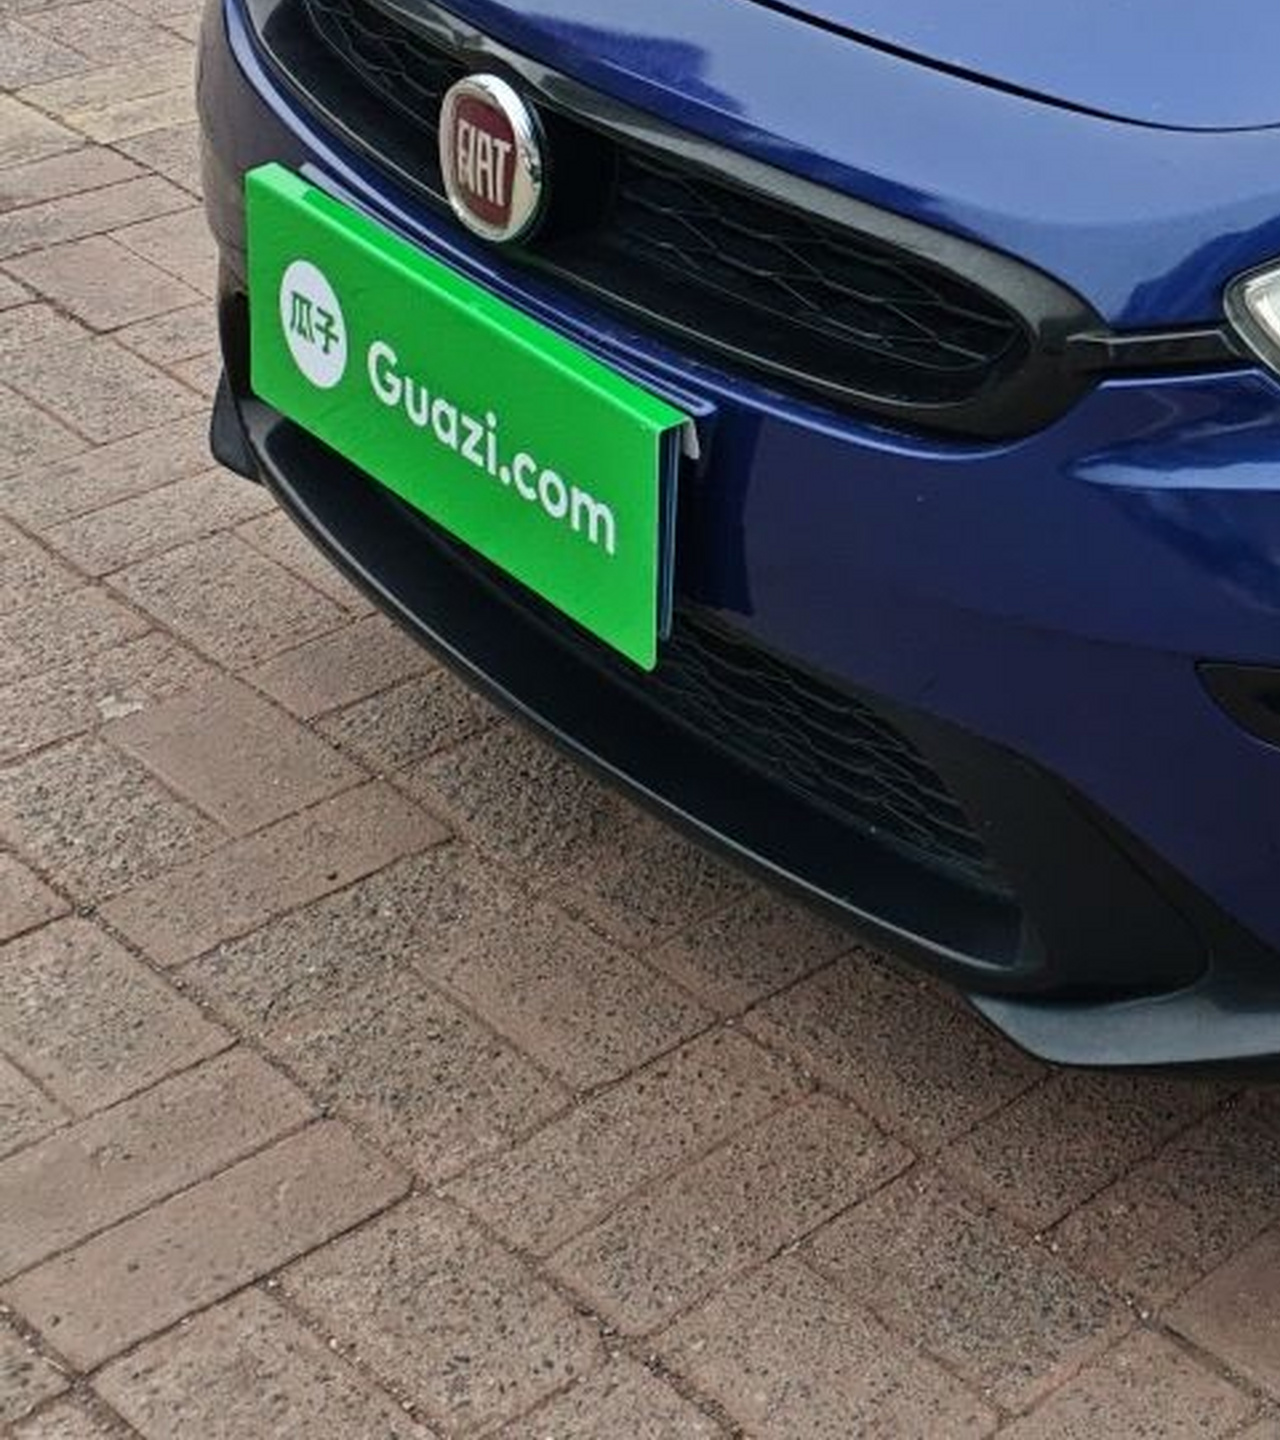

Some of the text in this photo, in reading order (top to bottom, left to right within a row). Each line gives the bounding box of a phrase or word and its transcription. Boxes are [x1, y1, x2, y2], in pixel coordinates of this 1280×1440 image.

[457, 118, 513, 208] FIAT
[290, 291, 341, 356] 瓜子
[367, 340, 616, 555] Guazi.com
